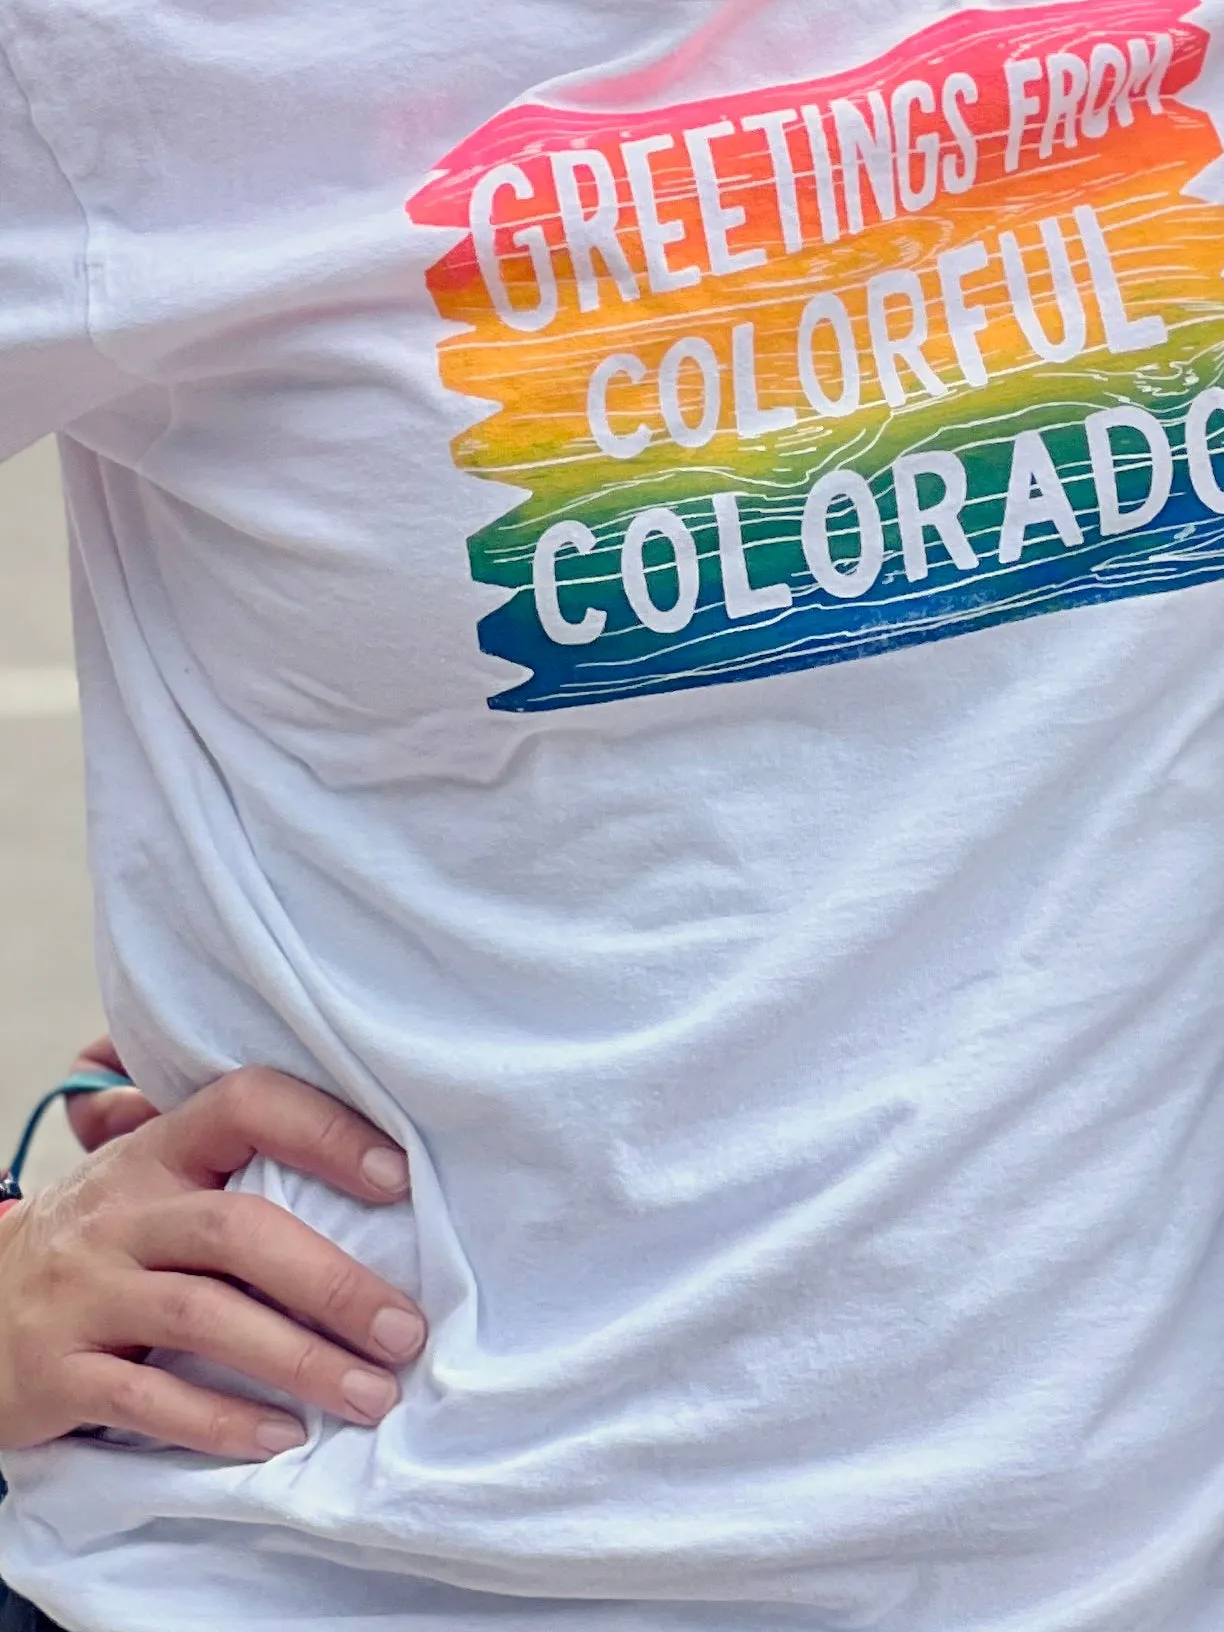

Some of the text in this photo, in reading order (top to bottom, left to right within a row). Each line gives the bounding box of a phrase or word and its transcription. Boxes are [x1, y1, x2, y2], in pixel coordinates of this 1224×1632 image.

[468, 32, 1174, 333] GREETINGS FROM
[586, 204, 1169, 459] COLORFUL
